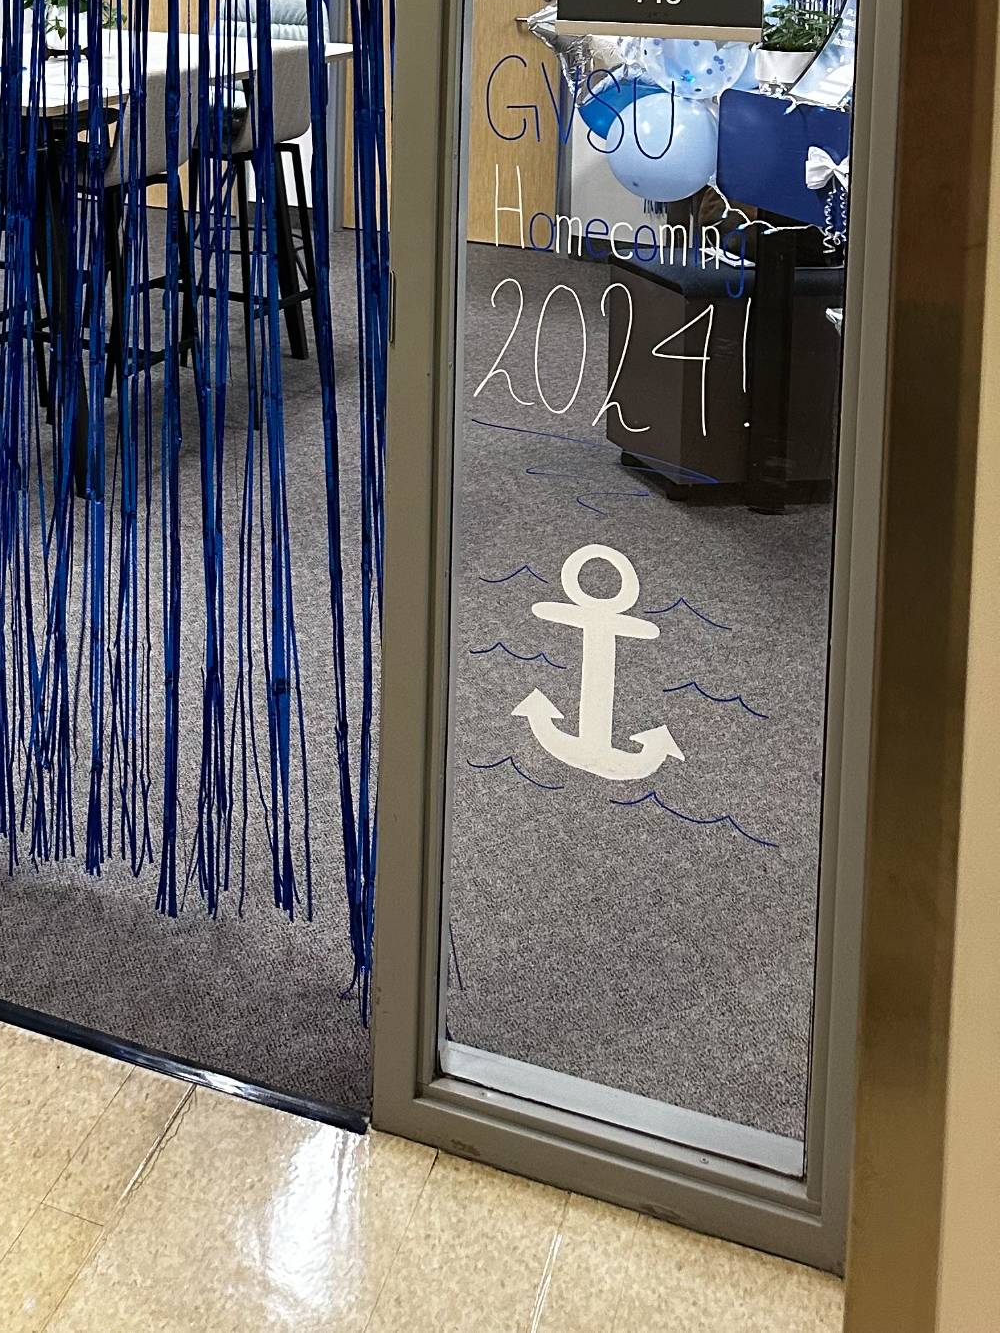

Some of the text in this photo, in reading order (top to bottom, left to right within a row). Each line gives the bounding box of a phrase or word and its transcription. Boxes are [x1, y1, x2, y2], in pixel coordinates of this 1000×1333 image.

[486, 54, 676, 160] GVSU
[494, 163, 746, 299] Homecoming
[473, 277, 753, 437] 2024!
